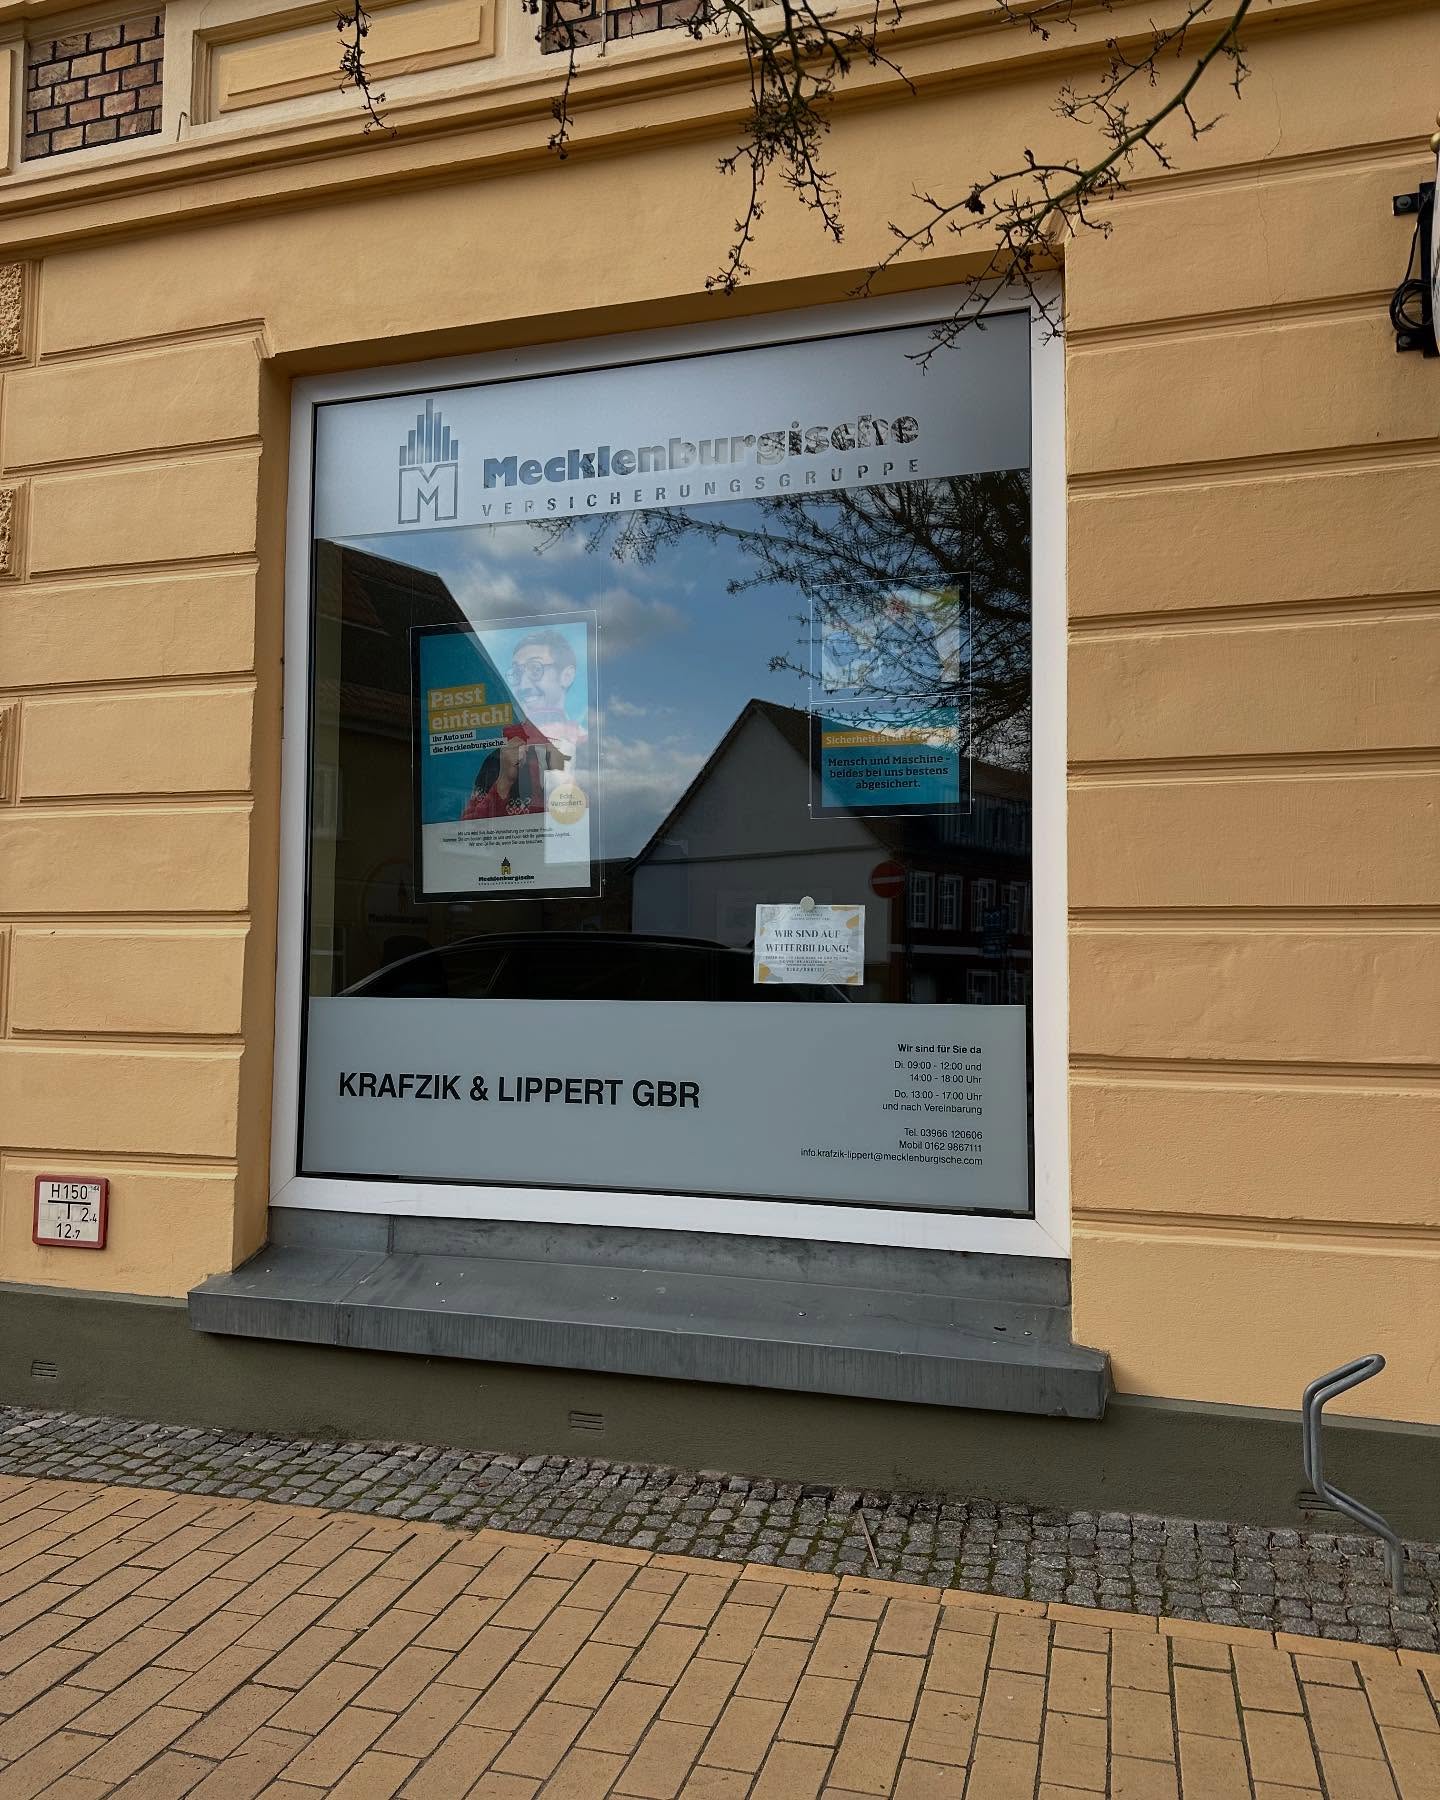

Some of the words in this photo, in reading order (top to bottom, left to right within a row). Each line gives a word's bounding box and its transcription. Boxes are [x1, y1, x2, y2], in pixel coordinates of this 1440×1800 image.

[483, 414, 920, 488] Mecklenburgische
[481, 458, 919, 518] VERSICHERUNGSGRUPPE
[431, 687, 482, 708] Passt
[432, 704, 510, 730] einfach!
[432, 735, 443, 743] Ihr
[443, 733, 459, 741] Auto
[460, 731, 473, 739] und
[826, 733, 875, 745] Sicherheit
[432, 746, 443, 754] die
[828, 755, 868, 767] Mensch
[870, 755, 890, 766] und
[892, 754, 944, 765] Maschine
[829, 768, 864, 778] beides
[866, 768, 882, 777] bei
[884, 768, 904, 776] uns
[905, 766, 949, 776] bestens
[855, 778, 921, 790] abgesichert.
[774, 929, 793, 938] WIR
[796, 929, 818, 938] SIND
[820, 929, 840, 939] AUF
[765, 943, 850, 953] WEITERBILDUNG!
[897, 1043, 913, 1052] Wir
[915, 1045, 935, 1053] sind
[937, 1045, 950, 1053] für
[953, 1045, 968, 1054] Sie
[970, 1046, 982, 1054] da
[894, 1060, 905, 1069] Di.
[907, 1061, 931, 1070] 09:00
[940, 1062, 963, 1071] 12:00
[965, 1063, 982, 1071] und
[910, 1073, 932, 1082] 14:00
[941, 1074, 964, 1083] 18:00
[966, 1075, 982, 1083] Uhr
[339, 1072, 461, 1100] KRAFZIK
[469, 1075, 489, 1101] &
[498, 1076, 624, 1105] LIPPERT
[632, 1080, 701, 1108] GBR
[894, 1089, 908, 1098] Do.
[911, 1090, 933, 1099] 13:00
[942, 1092, 964, 1100] 17:00
[966, 1092, 983, 1101] Uhr
[882, 1102, 899, 1111] und
[900, 1103, 922, 1111] nach
[924, 1103, 983, 1115] Vereinbarung
[904, 1127, 918, 1136] Tel.
[920, 1128, 948, 1138] 03966
[951, 1130, 983, 1140] 120606
[899, 1140, 922, 1149] Mobil
[924, 1141, 946, 1151] 0162
[947, 1142, 982, 1152] 9867111
